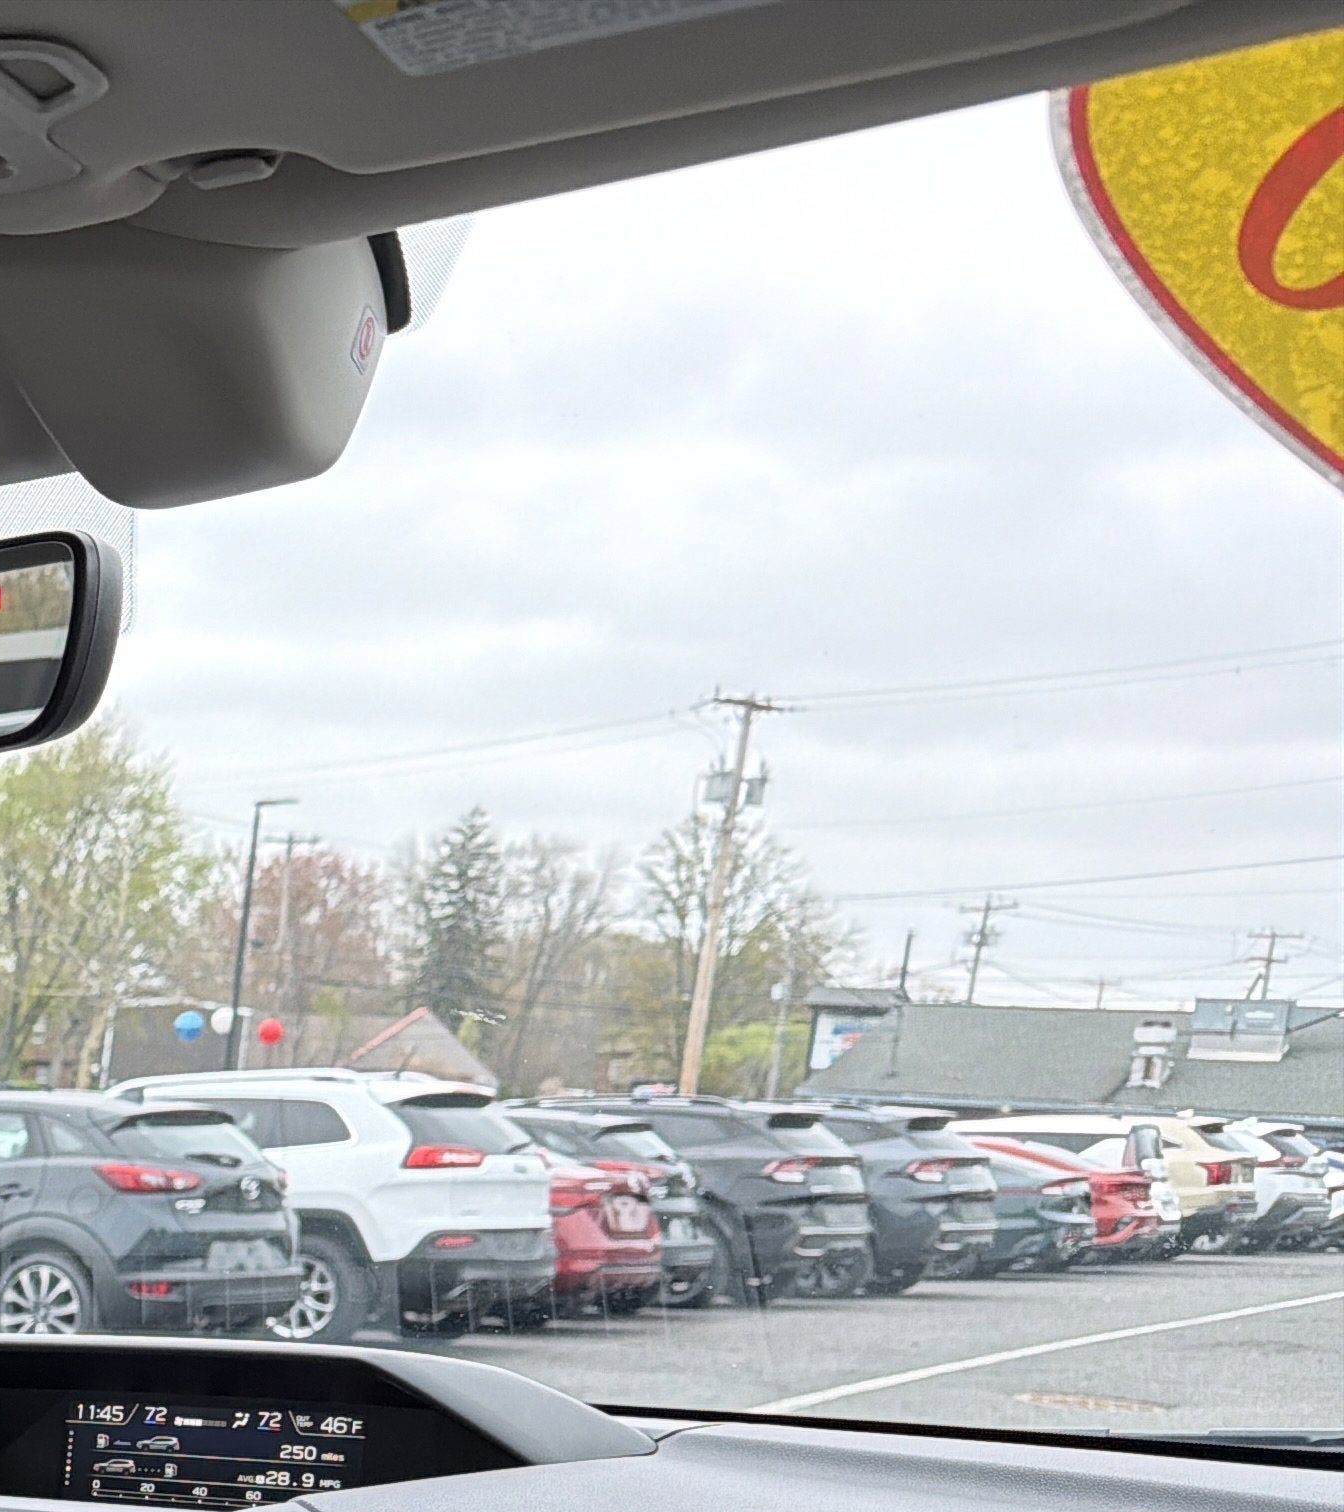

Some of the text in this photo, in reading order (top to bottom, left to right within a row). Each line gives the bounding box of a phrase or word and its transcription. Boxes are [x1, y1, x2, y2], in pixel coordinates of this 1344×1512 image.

[77, 1403, 125, 1422] 11:45
[144, 1406, 168, 1422] 72
[257, 1411, 283, 1428] 72
[280, 1444, 317, 1461] 250
[321, 1452, 345, 1462] miles
[92, 1479, 101, 1489] 0
[266, 1470, 315, 1488] 28.9
[319, 1479, 342, 1489] MPG
[140, 1482, 156, 1493] 20
[192, 1486, 208, 1497] 40
[245, 1490, 262, 1501] 60
